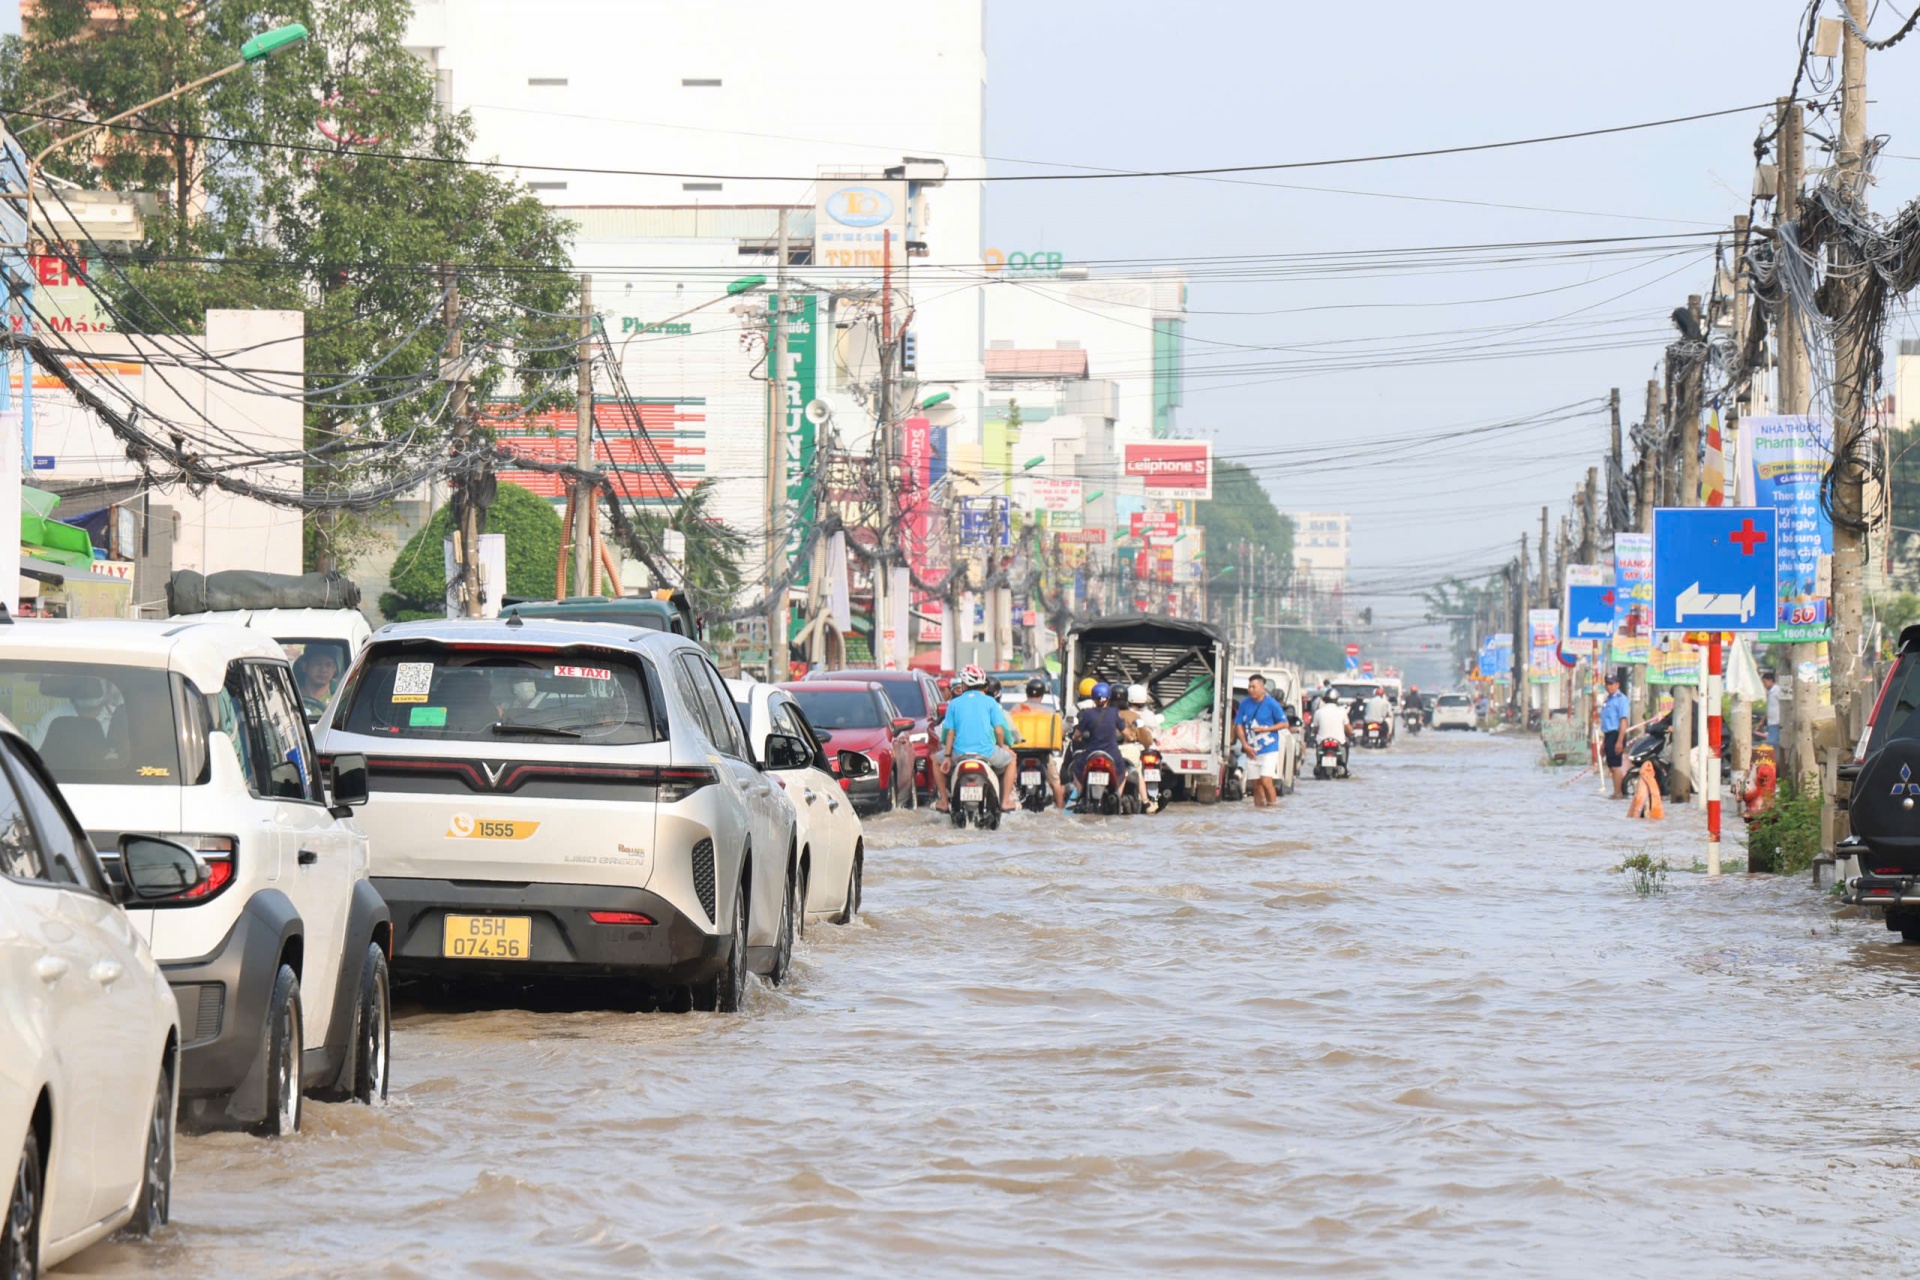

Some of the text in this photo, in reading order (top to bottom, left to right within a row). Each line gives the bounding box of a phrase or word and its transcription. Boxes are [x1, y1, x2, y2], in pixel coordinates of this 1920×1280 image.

[1007, 251, 1063, 270] OCB
[51, 315, 106, 332] Máy
[622, 317, 691, 334] Pharma
[1761, 424, 1784, 434] NHÀ
[1755, 436, 1831, 450] Pharmacity
[1779, 504, 1816, 517] uyết áp
[1794, 535, 1821, 545] sung
[1798, 546, 1822, 557] chất
[558, 666, 609, 679] XE TAXI
[137, 766, 170, 777] XPEL
[479, 822, 514, 837] 1555
[564, 855, 644, 866] LIMO GREEN
[470, 919, 506, 936] 65H
[454, 938, 519, 957] 074.56
